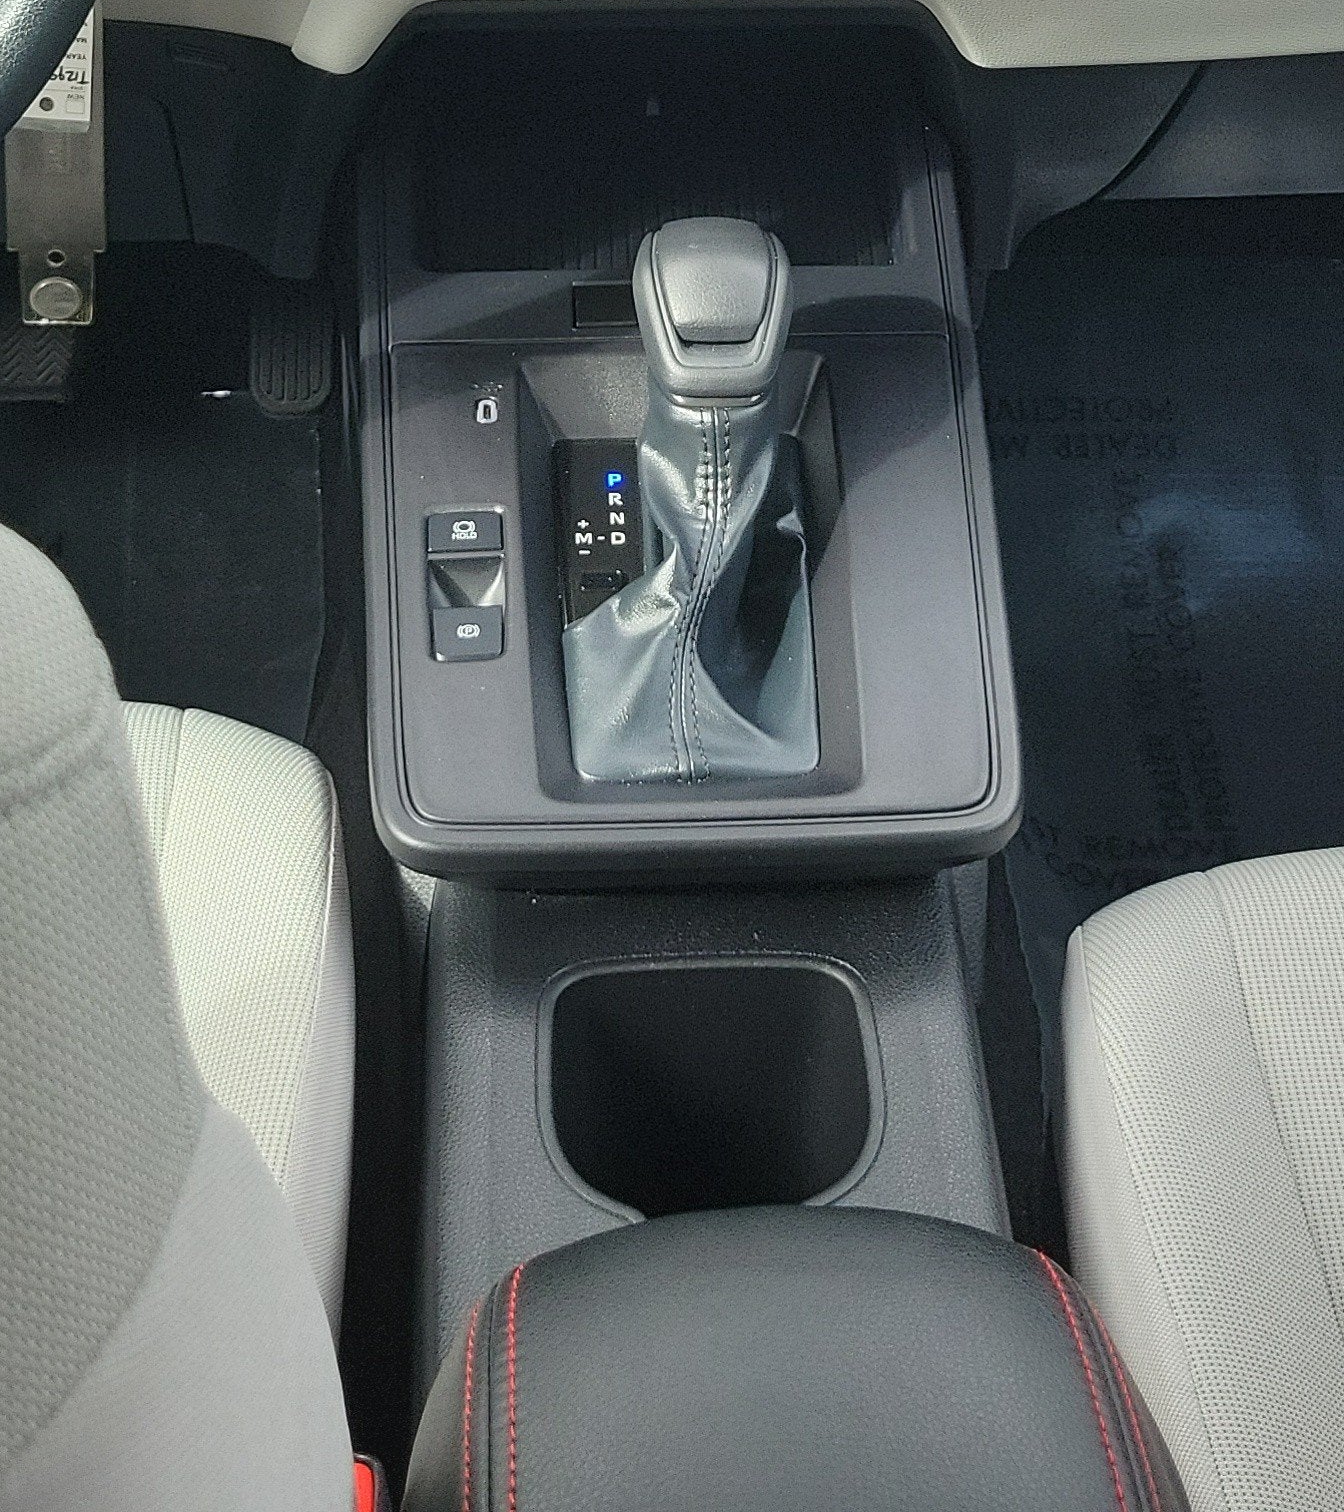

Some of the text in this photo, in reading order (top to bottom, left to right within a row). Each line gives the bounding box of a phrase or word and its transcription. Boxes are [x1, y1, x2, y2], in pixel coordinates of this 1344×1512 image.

[607, 473, 622, 486] P
[608, 493, 623, 506] R
[609, 512, 625, 525] N
[574, 531, 626, 545] M D
